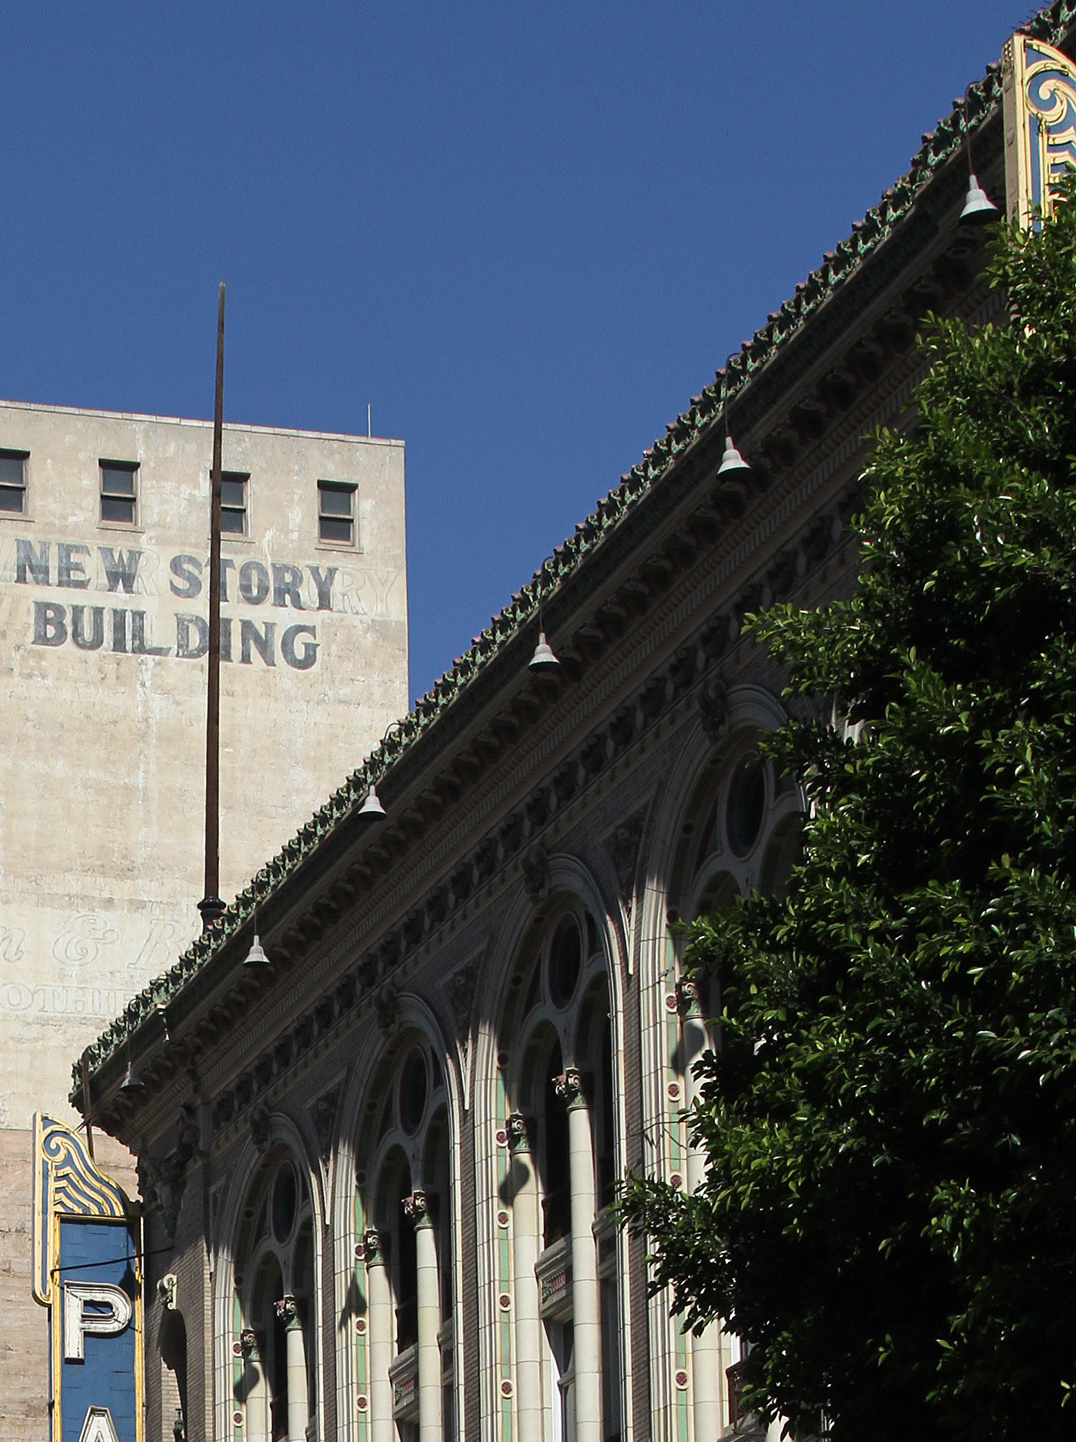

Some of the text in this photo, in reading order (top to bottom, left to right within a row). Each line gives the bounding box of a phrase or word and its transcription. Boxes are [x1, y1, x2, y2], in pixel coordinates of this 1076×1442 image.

[14, 538, 144, 594] NEW
[170, 553, 340, 612] STORY
[31, 600, 321, 670] BUILDING
